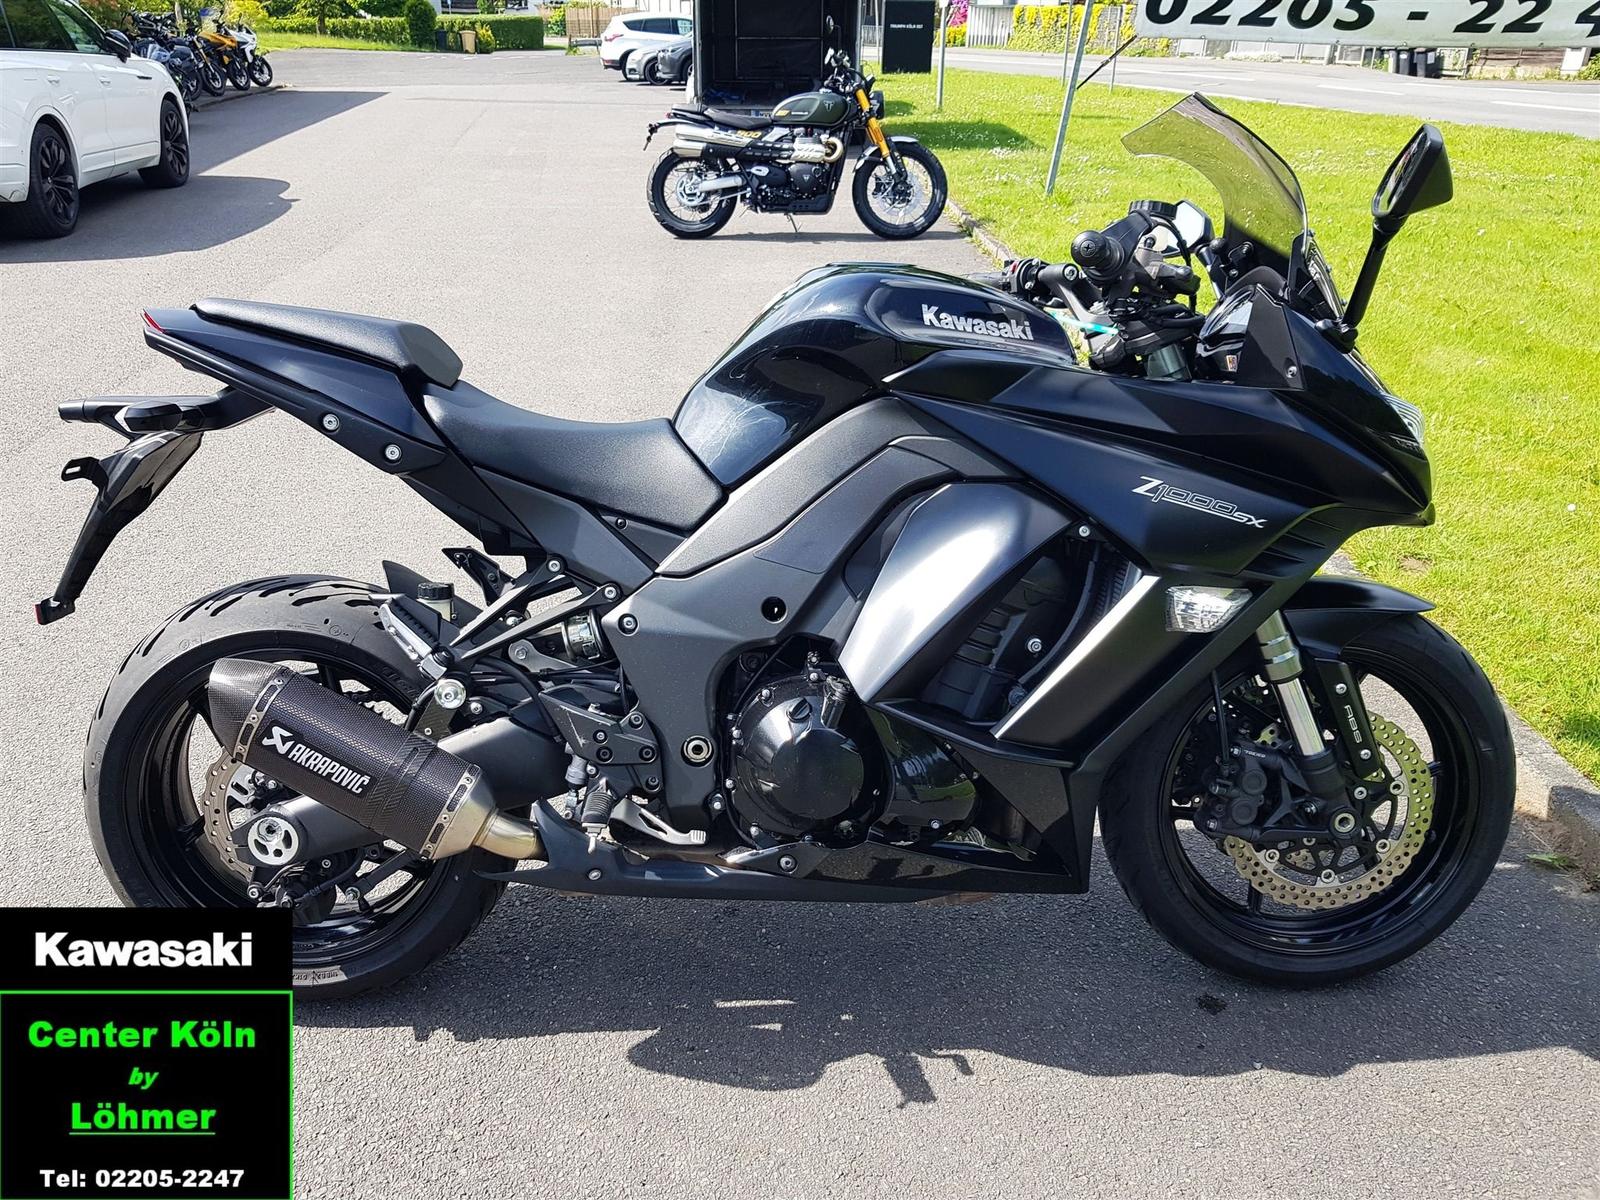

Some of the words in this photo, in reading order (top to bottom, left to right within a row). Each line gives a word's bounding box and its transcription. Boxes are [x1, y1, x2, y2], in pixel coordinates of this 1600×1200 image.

[1145, 0, 1375, 31] 02205
[1453, 0, 1553, 34] 22
[921, 303, 1034, 341] Kawasaki
[1131, 475, 1268, 529] Z1000SX
[1344, 704, 1363, 744] ABS
